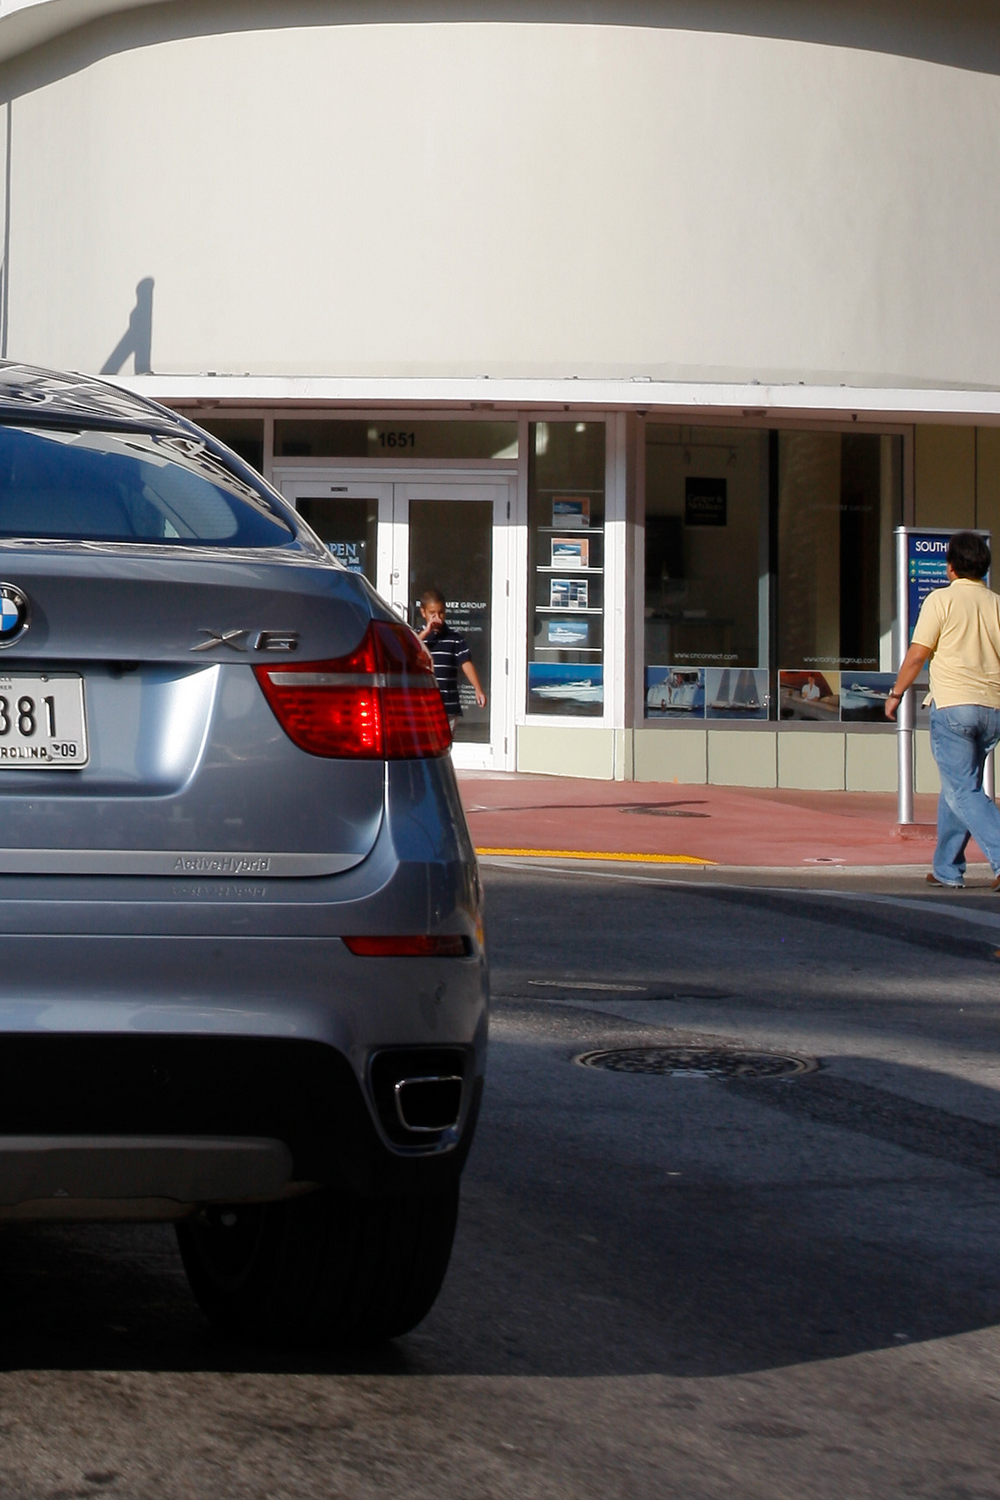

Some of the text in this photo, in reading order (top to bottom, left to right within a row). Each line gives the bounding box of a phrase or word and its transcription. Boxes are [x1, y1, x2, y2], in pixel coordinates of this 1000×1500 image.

[379, 432, 415, 448] 1651
[915, 541, 947, 552] SOUTH
[189, 628, 299, 652] X6
[61, 743, 77, 757] 09
[174, 857, 272, 874] ActiveHybrid
